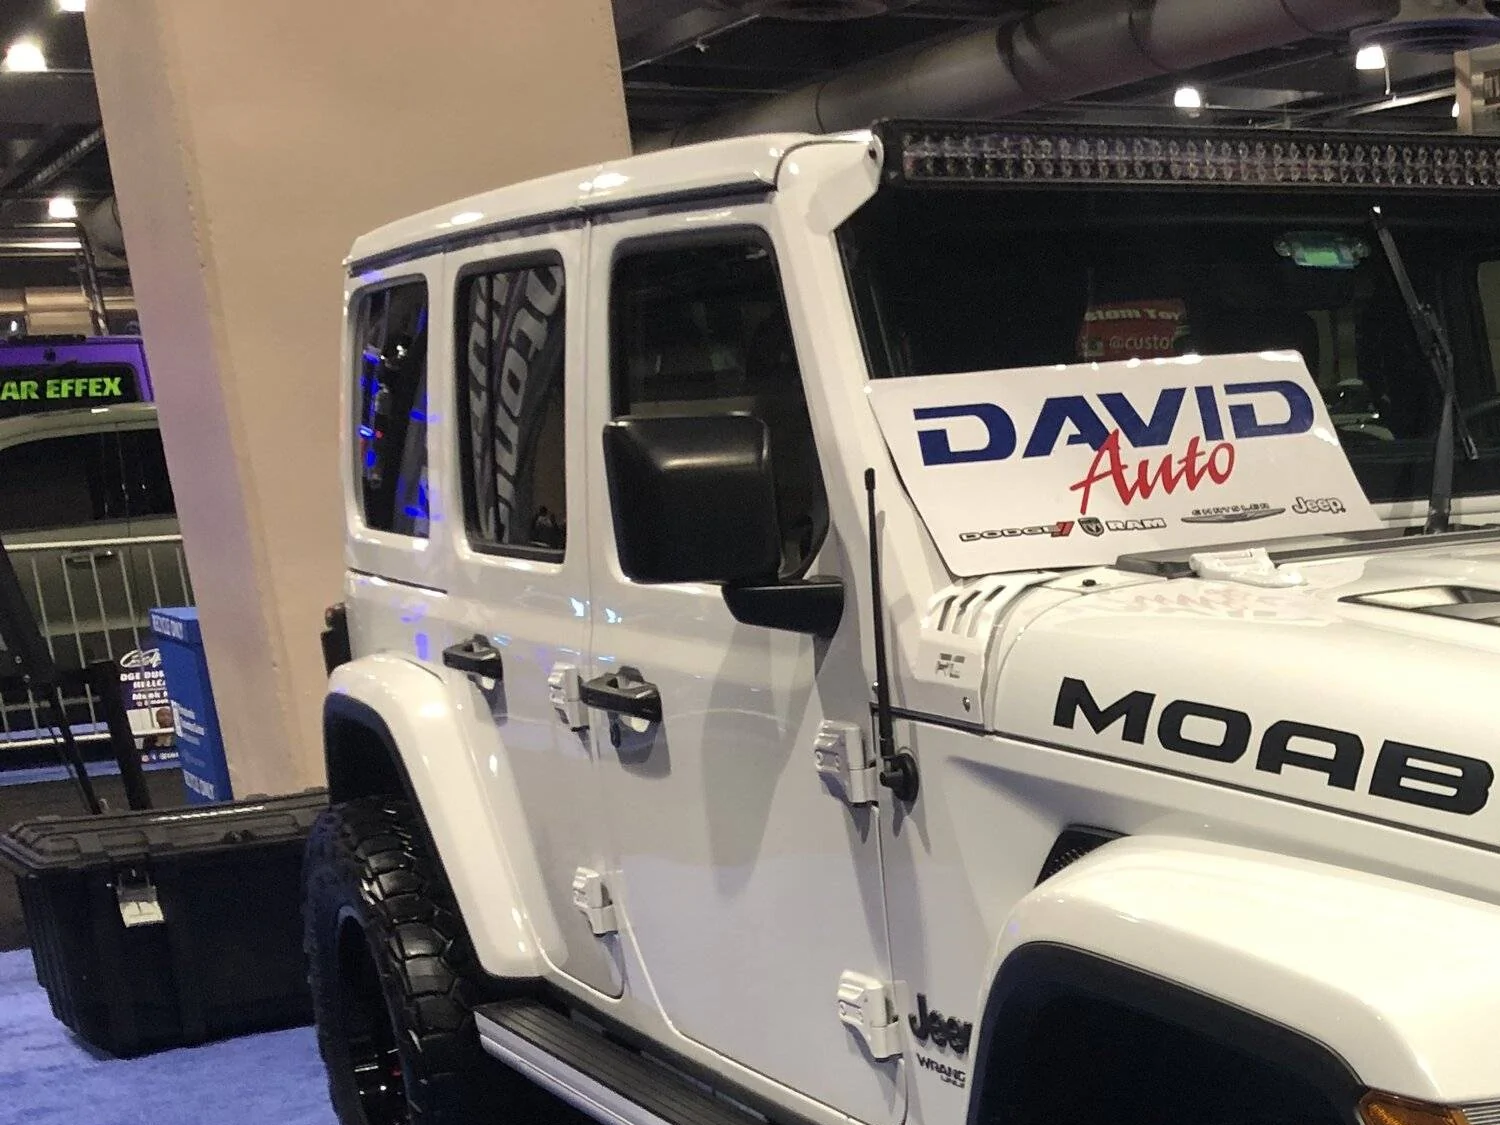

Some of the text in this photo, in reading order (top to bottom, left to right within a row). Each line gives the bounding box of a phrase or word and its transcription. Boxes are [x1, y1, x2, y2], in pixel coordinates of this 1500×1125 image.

[1109, 335, 1174, 350] @custo
[0, 377, 122, 400] AR EFFEX
[913, 379, 1314, 467] DAVID
[1069, 428, 1235, 515] Auto
[960, 496, 1344, 542] DODGE RAM CHRYSLER Jeep
[1053, 676, 1495, 815] MOAB
[916, 1052, 966, 1082] WRANG
